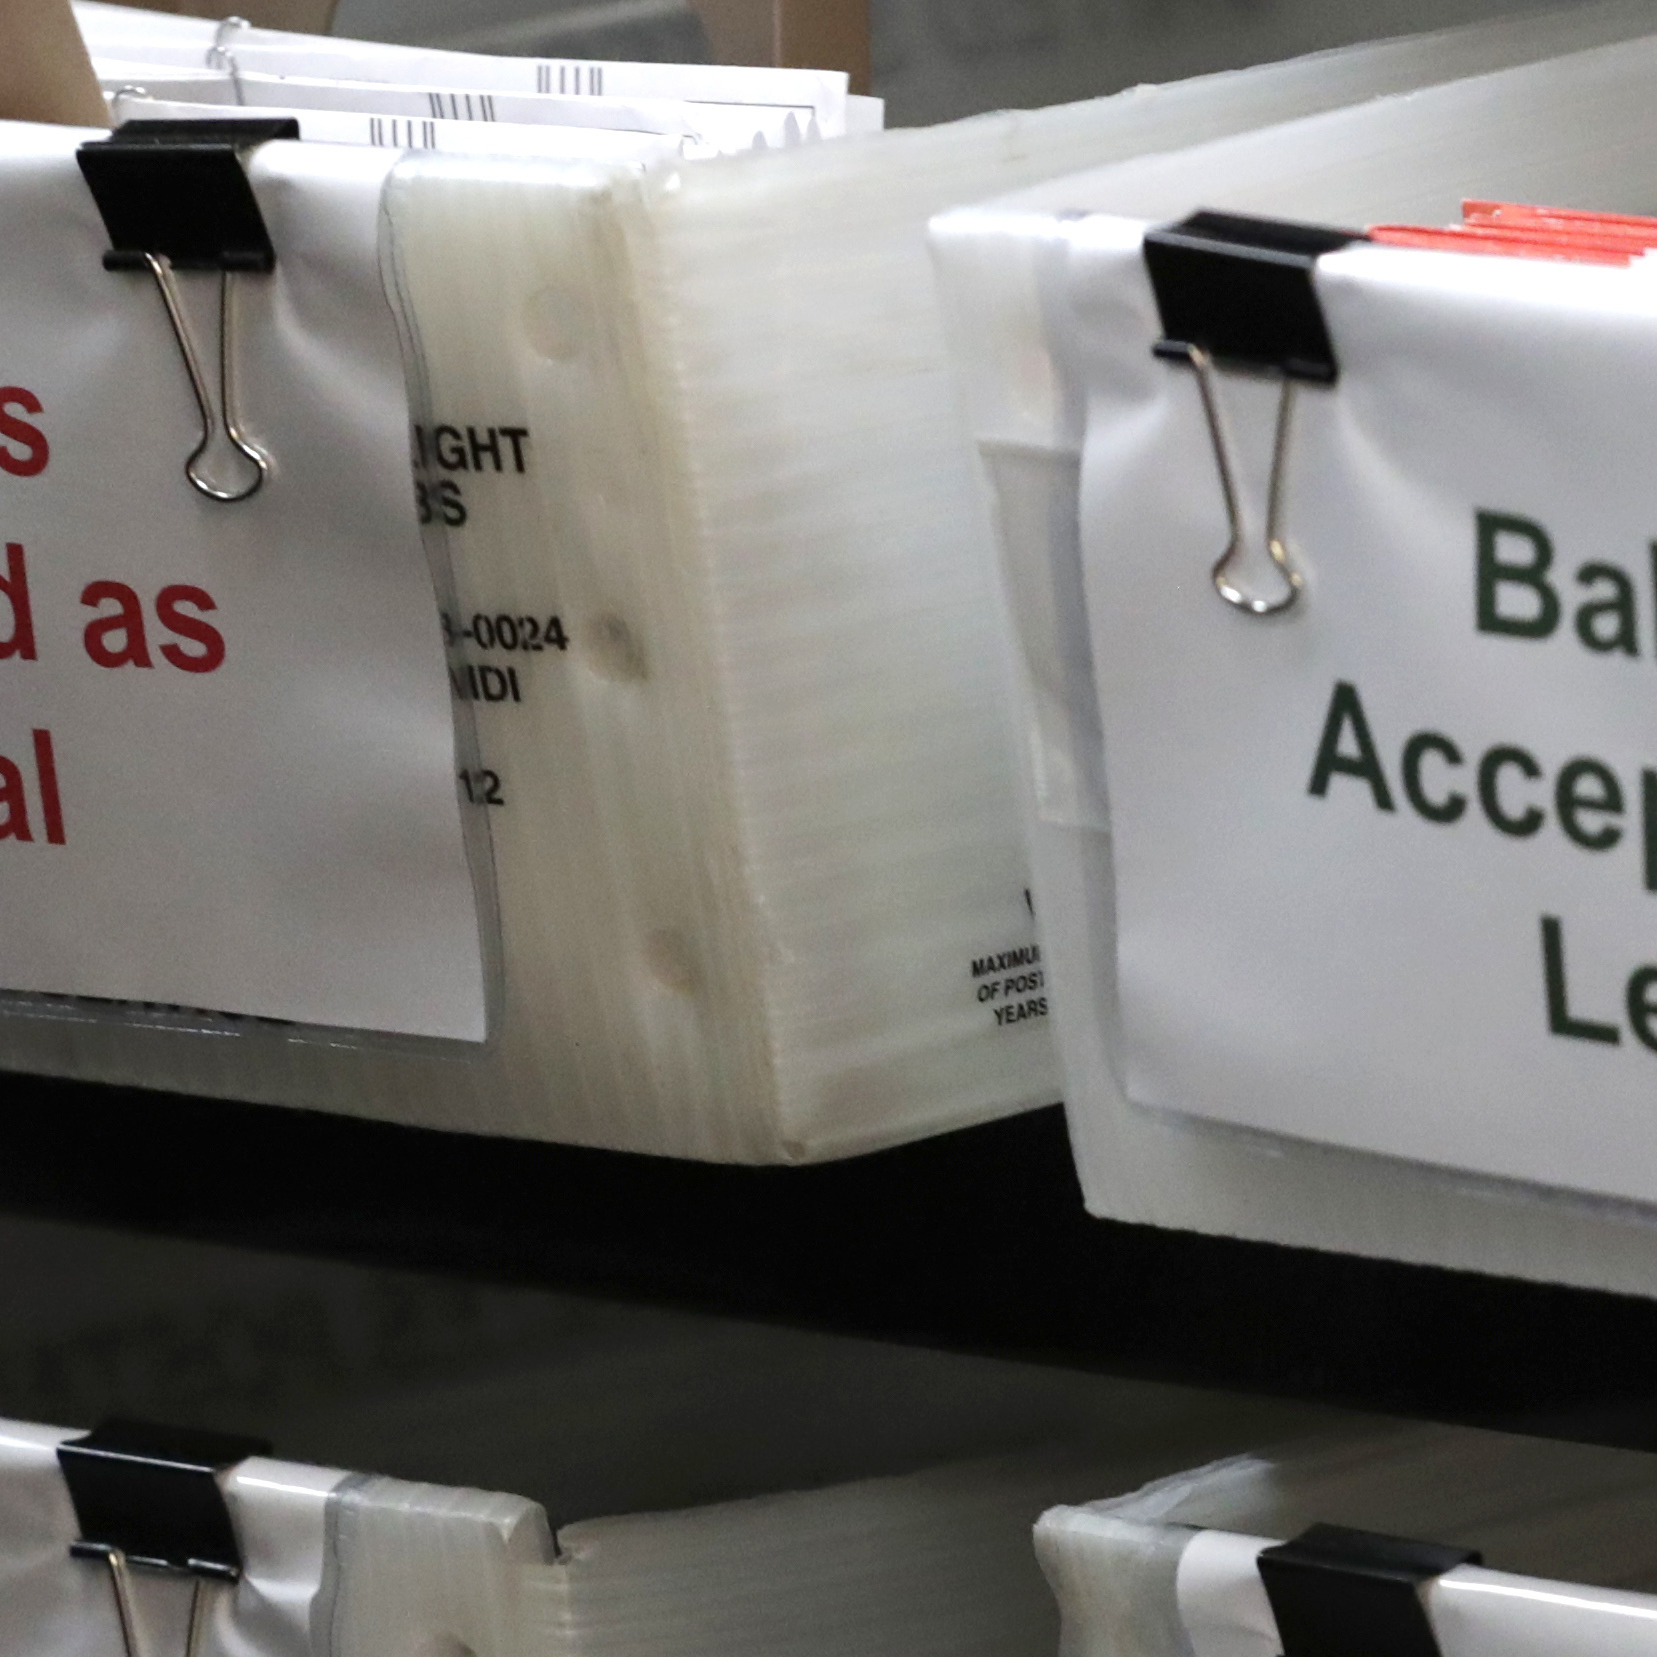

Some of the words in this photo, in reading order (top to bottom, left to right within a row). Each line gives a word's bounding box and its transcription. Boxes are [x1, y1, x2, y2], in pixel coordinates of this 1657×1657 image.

[78, 577, 229, 676] as
[976, 979, 1002, 1004] OF
[991, 995, 1049, 1027] YEARS
